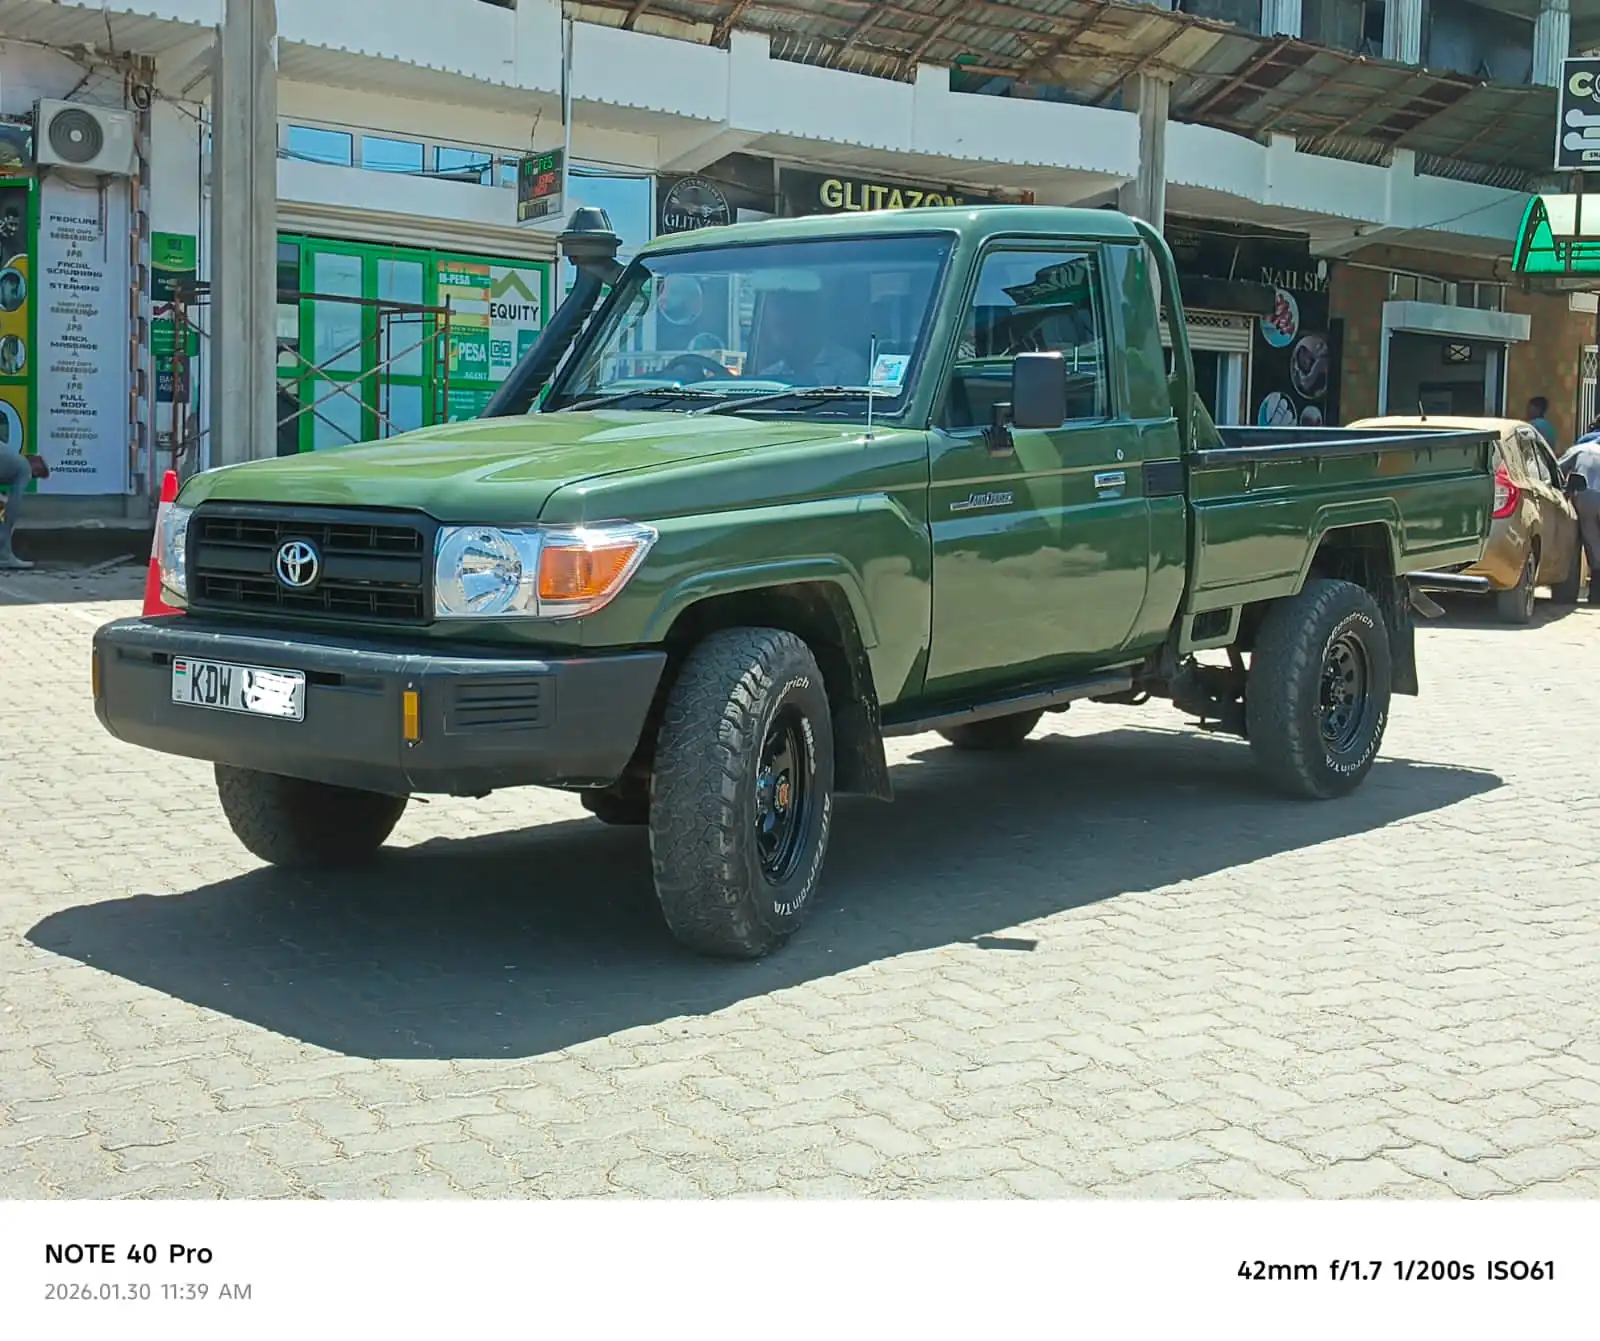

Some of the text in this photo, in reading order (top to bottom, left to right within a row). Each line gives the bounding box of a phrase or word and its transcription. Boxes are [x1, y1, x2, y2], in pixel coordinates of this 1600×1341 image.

[49, 215, 98, 225] PEDICURE
[490, 303, 539, 321] EQUITY
[191, 663, 232, 706] KDW
